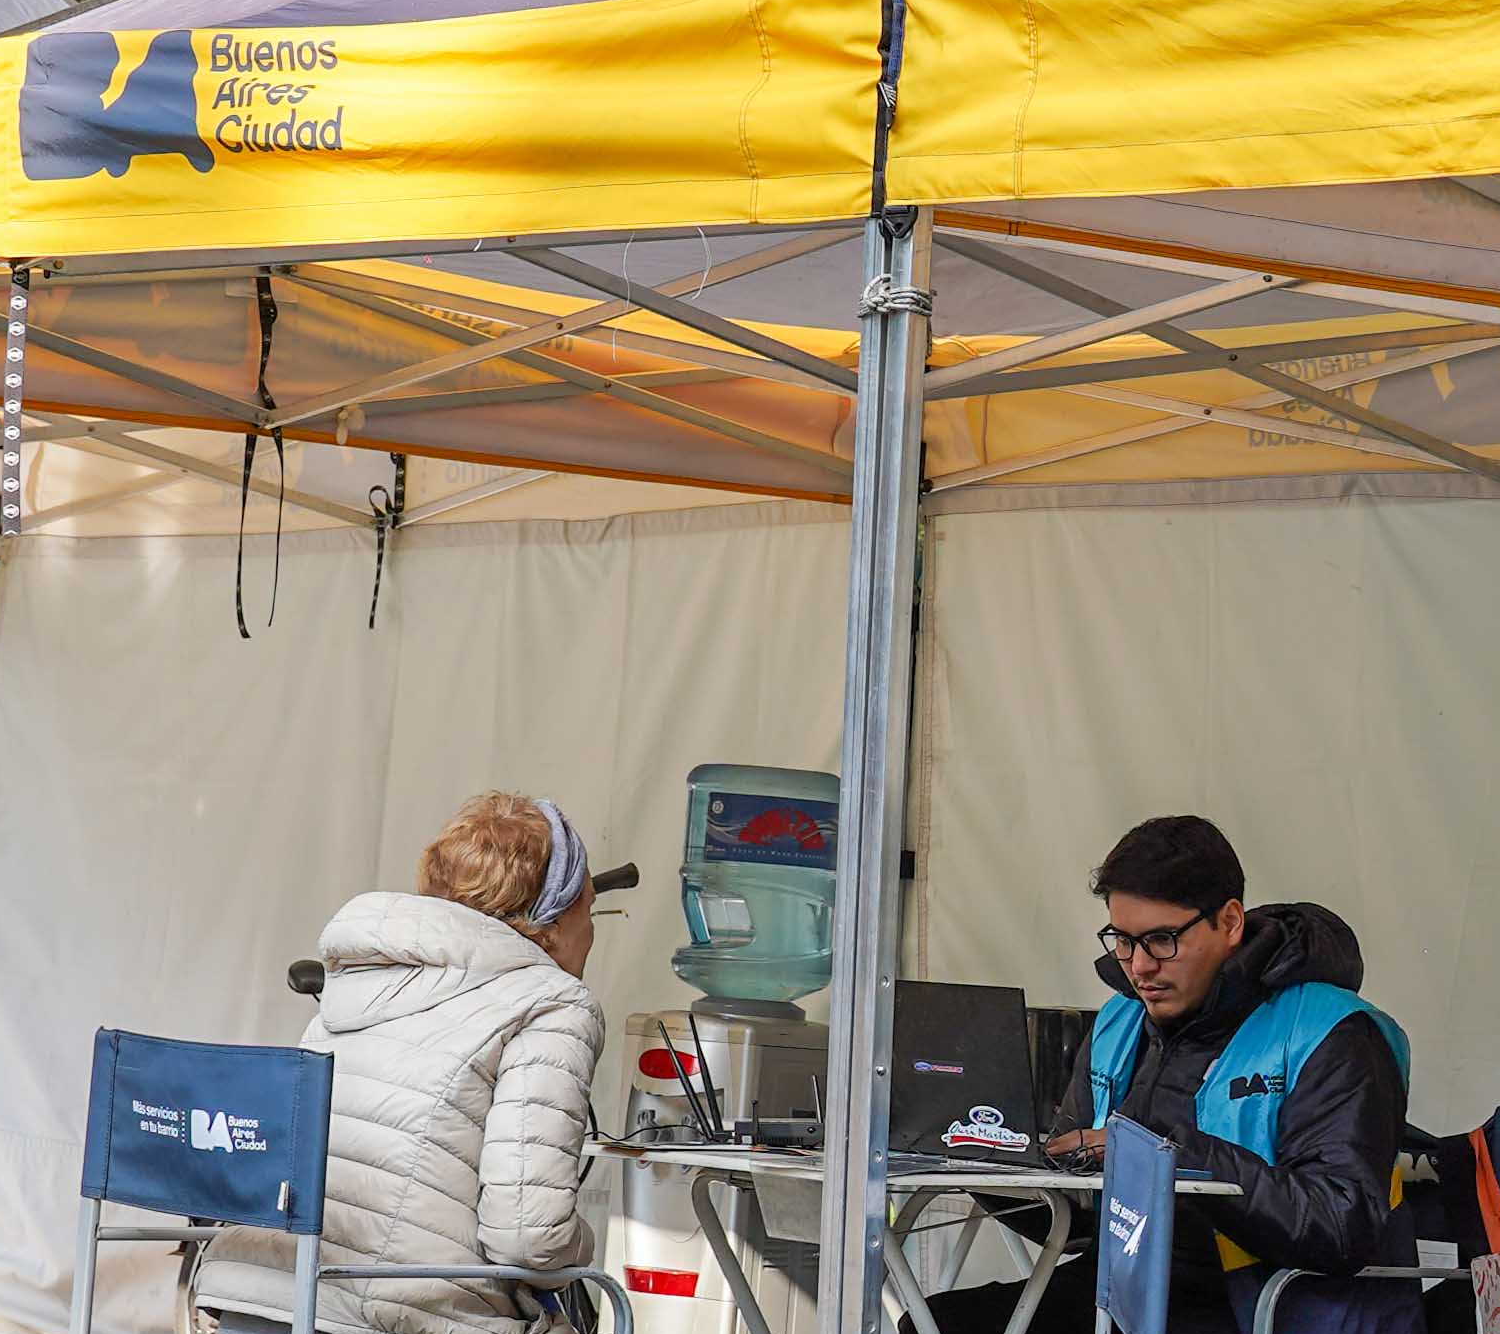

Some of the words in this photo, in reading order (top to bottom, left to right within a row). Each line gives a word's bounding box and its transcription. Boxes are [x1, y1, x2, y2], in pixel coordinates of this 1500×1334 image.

[210, 34, 338, 73] Buenos
[213, 78, 315, 111] Aires
[215, 106, 343, 153] Ciudad
[146, 1105, 179, 1121] servicios
[228, 1115, 258, 1128] Buenos
[232, 1128, 255, 1139] Aires
[234, 1139, 266, 1151] Ciudad
